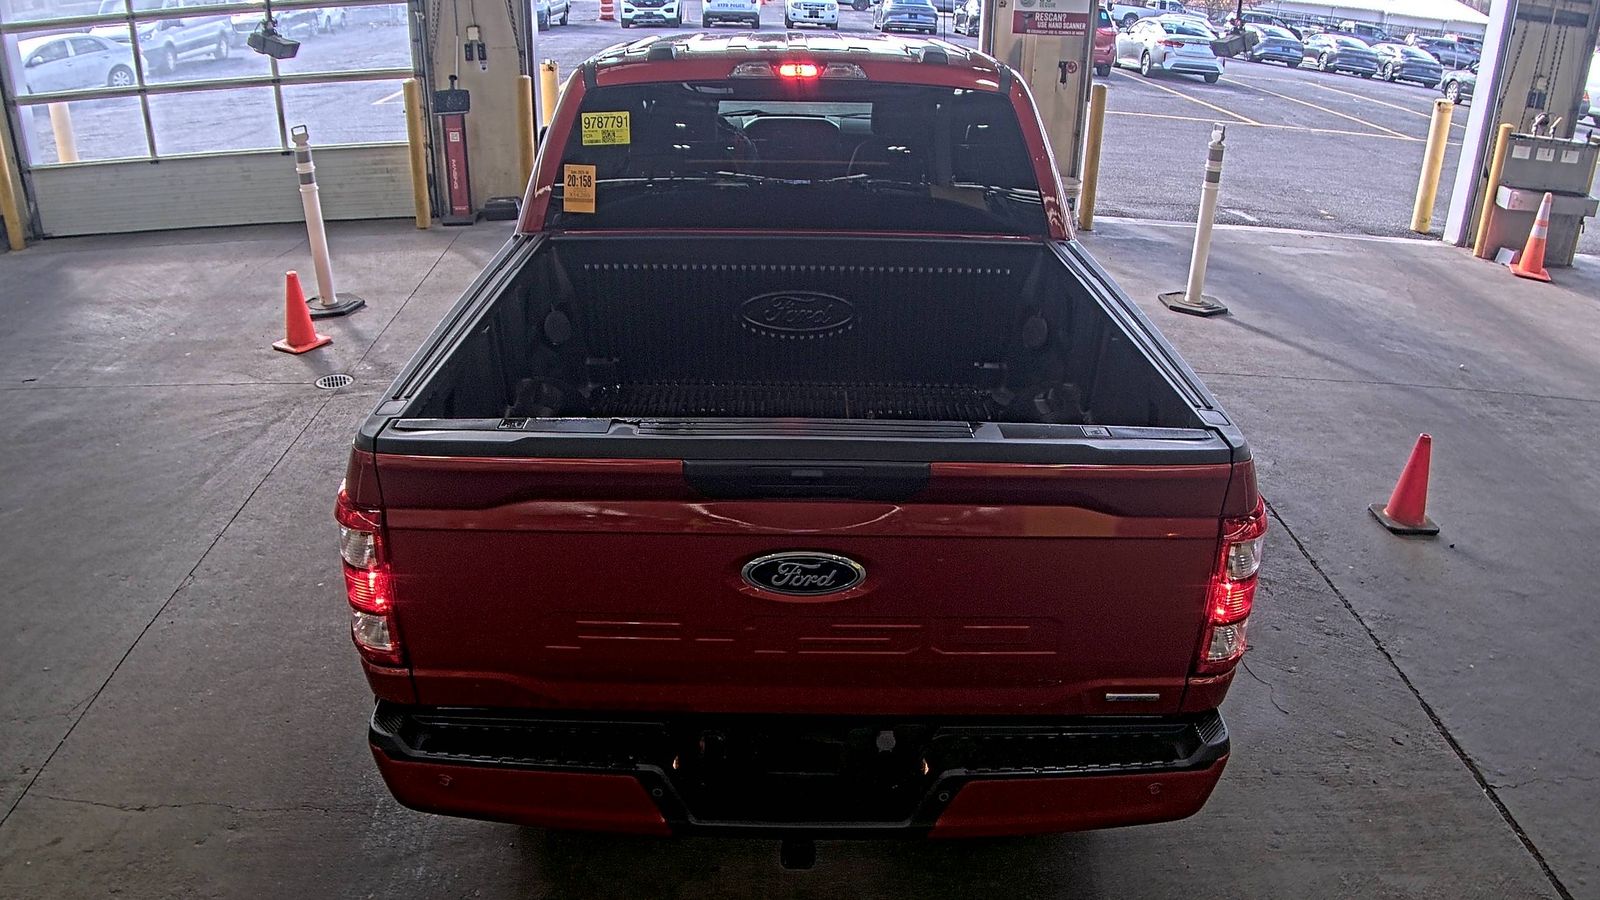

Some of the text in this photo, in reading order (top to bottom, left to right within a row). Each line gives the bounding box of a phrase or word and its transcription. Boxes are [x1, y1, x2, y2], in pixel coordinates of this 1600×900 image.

[1034, 12, 1067, 22] RESCAN?
[1037, 21, 1086, 30] USE HAND SCANNER
[583, 115, 628, 129] 9787791
[567, 174, 592, 188] 20:158
[771, 561, 837, 586] Ford
